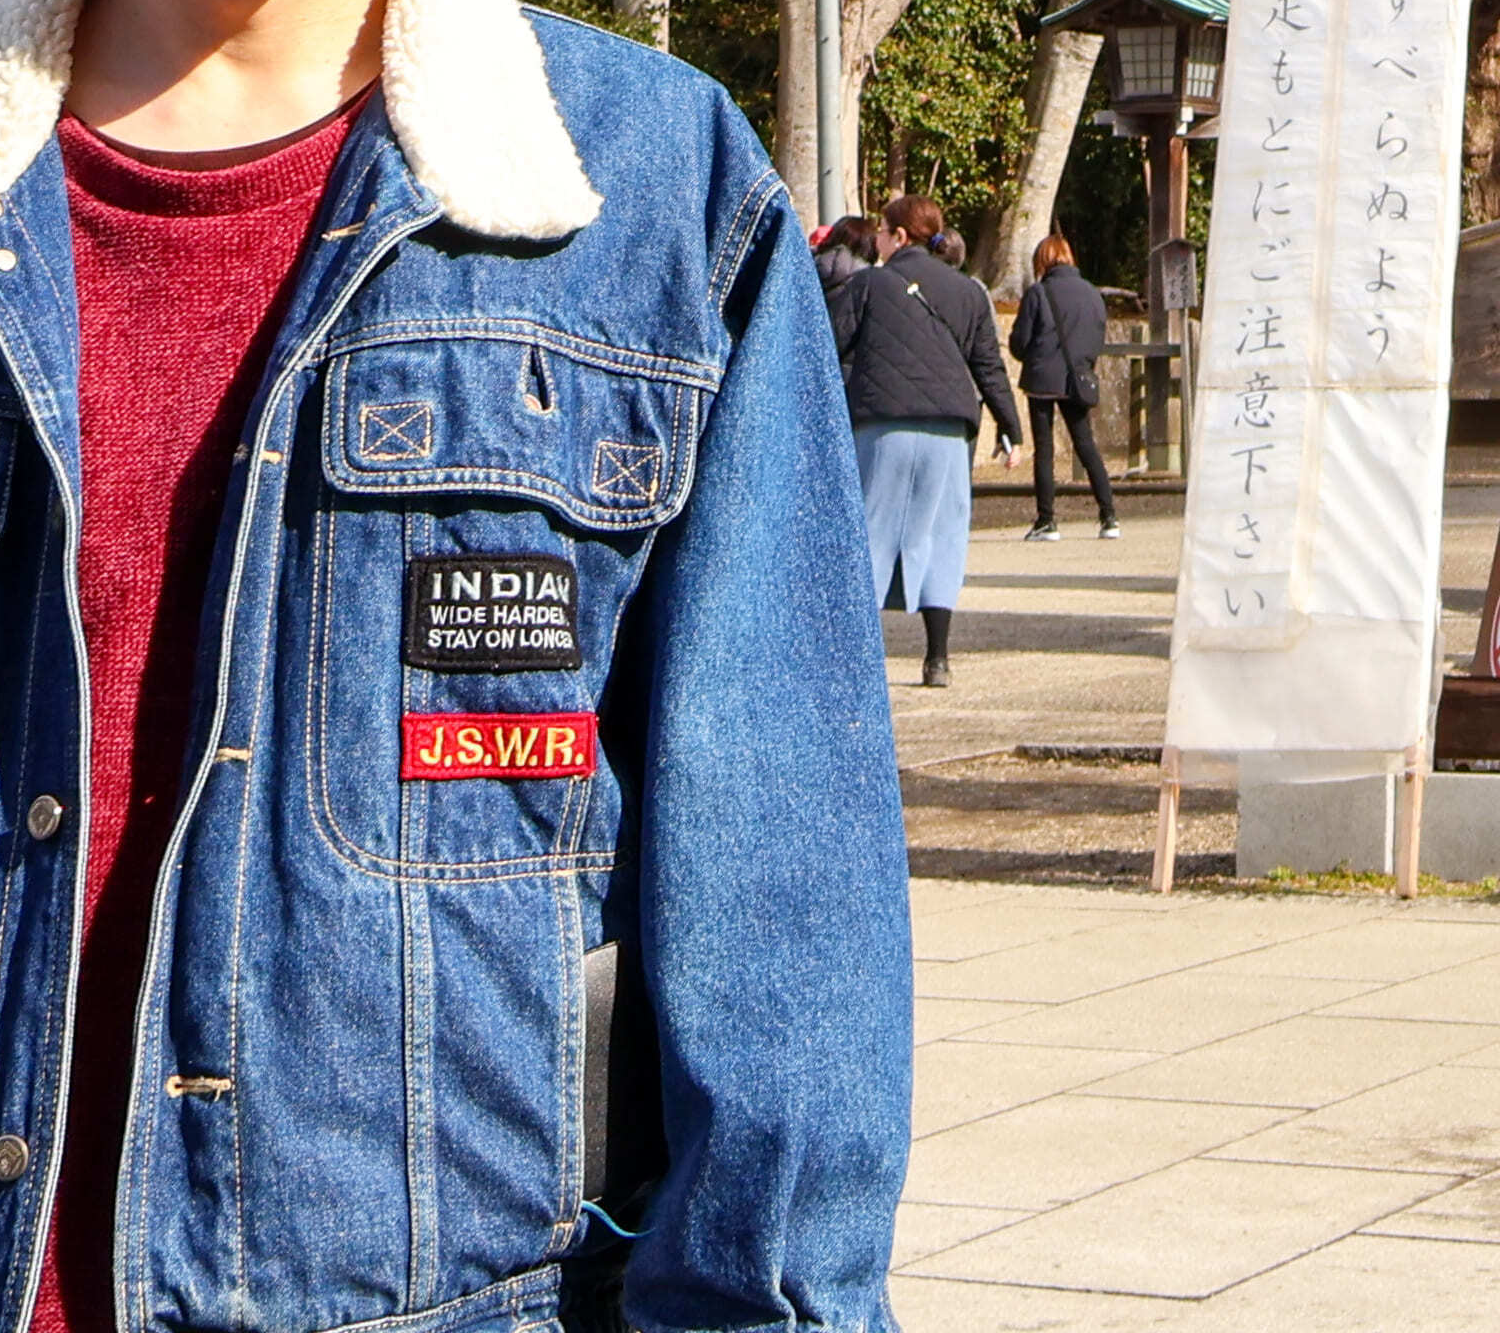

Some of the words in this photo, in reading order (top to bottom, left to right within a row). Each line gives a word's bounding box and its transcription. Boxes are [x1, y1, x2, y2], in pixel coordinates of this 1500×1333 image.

[430, 604, 487, 626] WIDE
[427, 627, 483, 650] STAY
[485, 629, 516, 650] ON
[419, 726, 584, 768] J.S.W.R.
